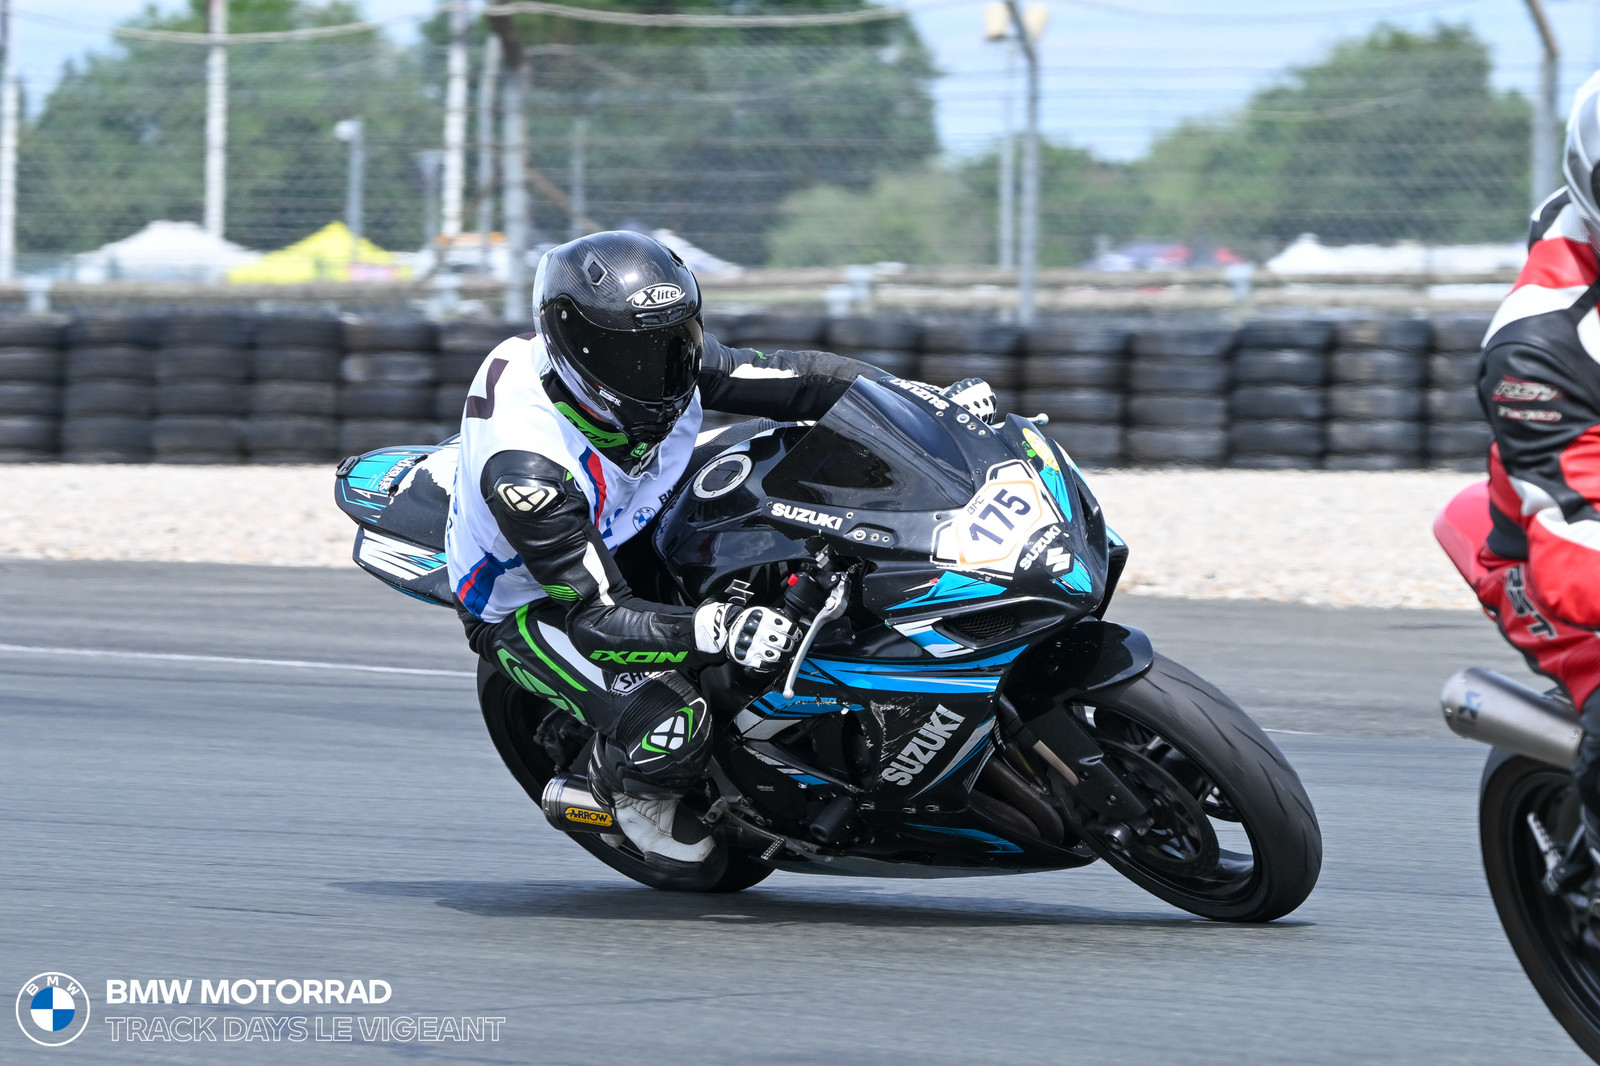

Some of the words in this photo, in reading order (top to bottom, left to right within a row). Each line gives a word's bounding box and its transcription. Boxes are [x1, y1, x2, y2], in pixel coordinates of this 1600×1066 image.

[640, 288, 677, 306] X-lite
[889, 378, 950, 410] SUZUKI
[771, 502, 843, 530] SUZUKI
[969, 488, 1031, 545] 175
[1019, 524, 1062, 571] SUZUKI
[881, 703, 965, 787] SUZUKI
[568, 808, 608, 823] ARROW
